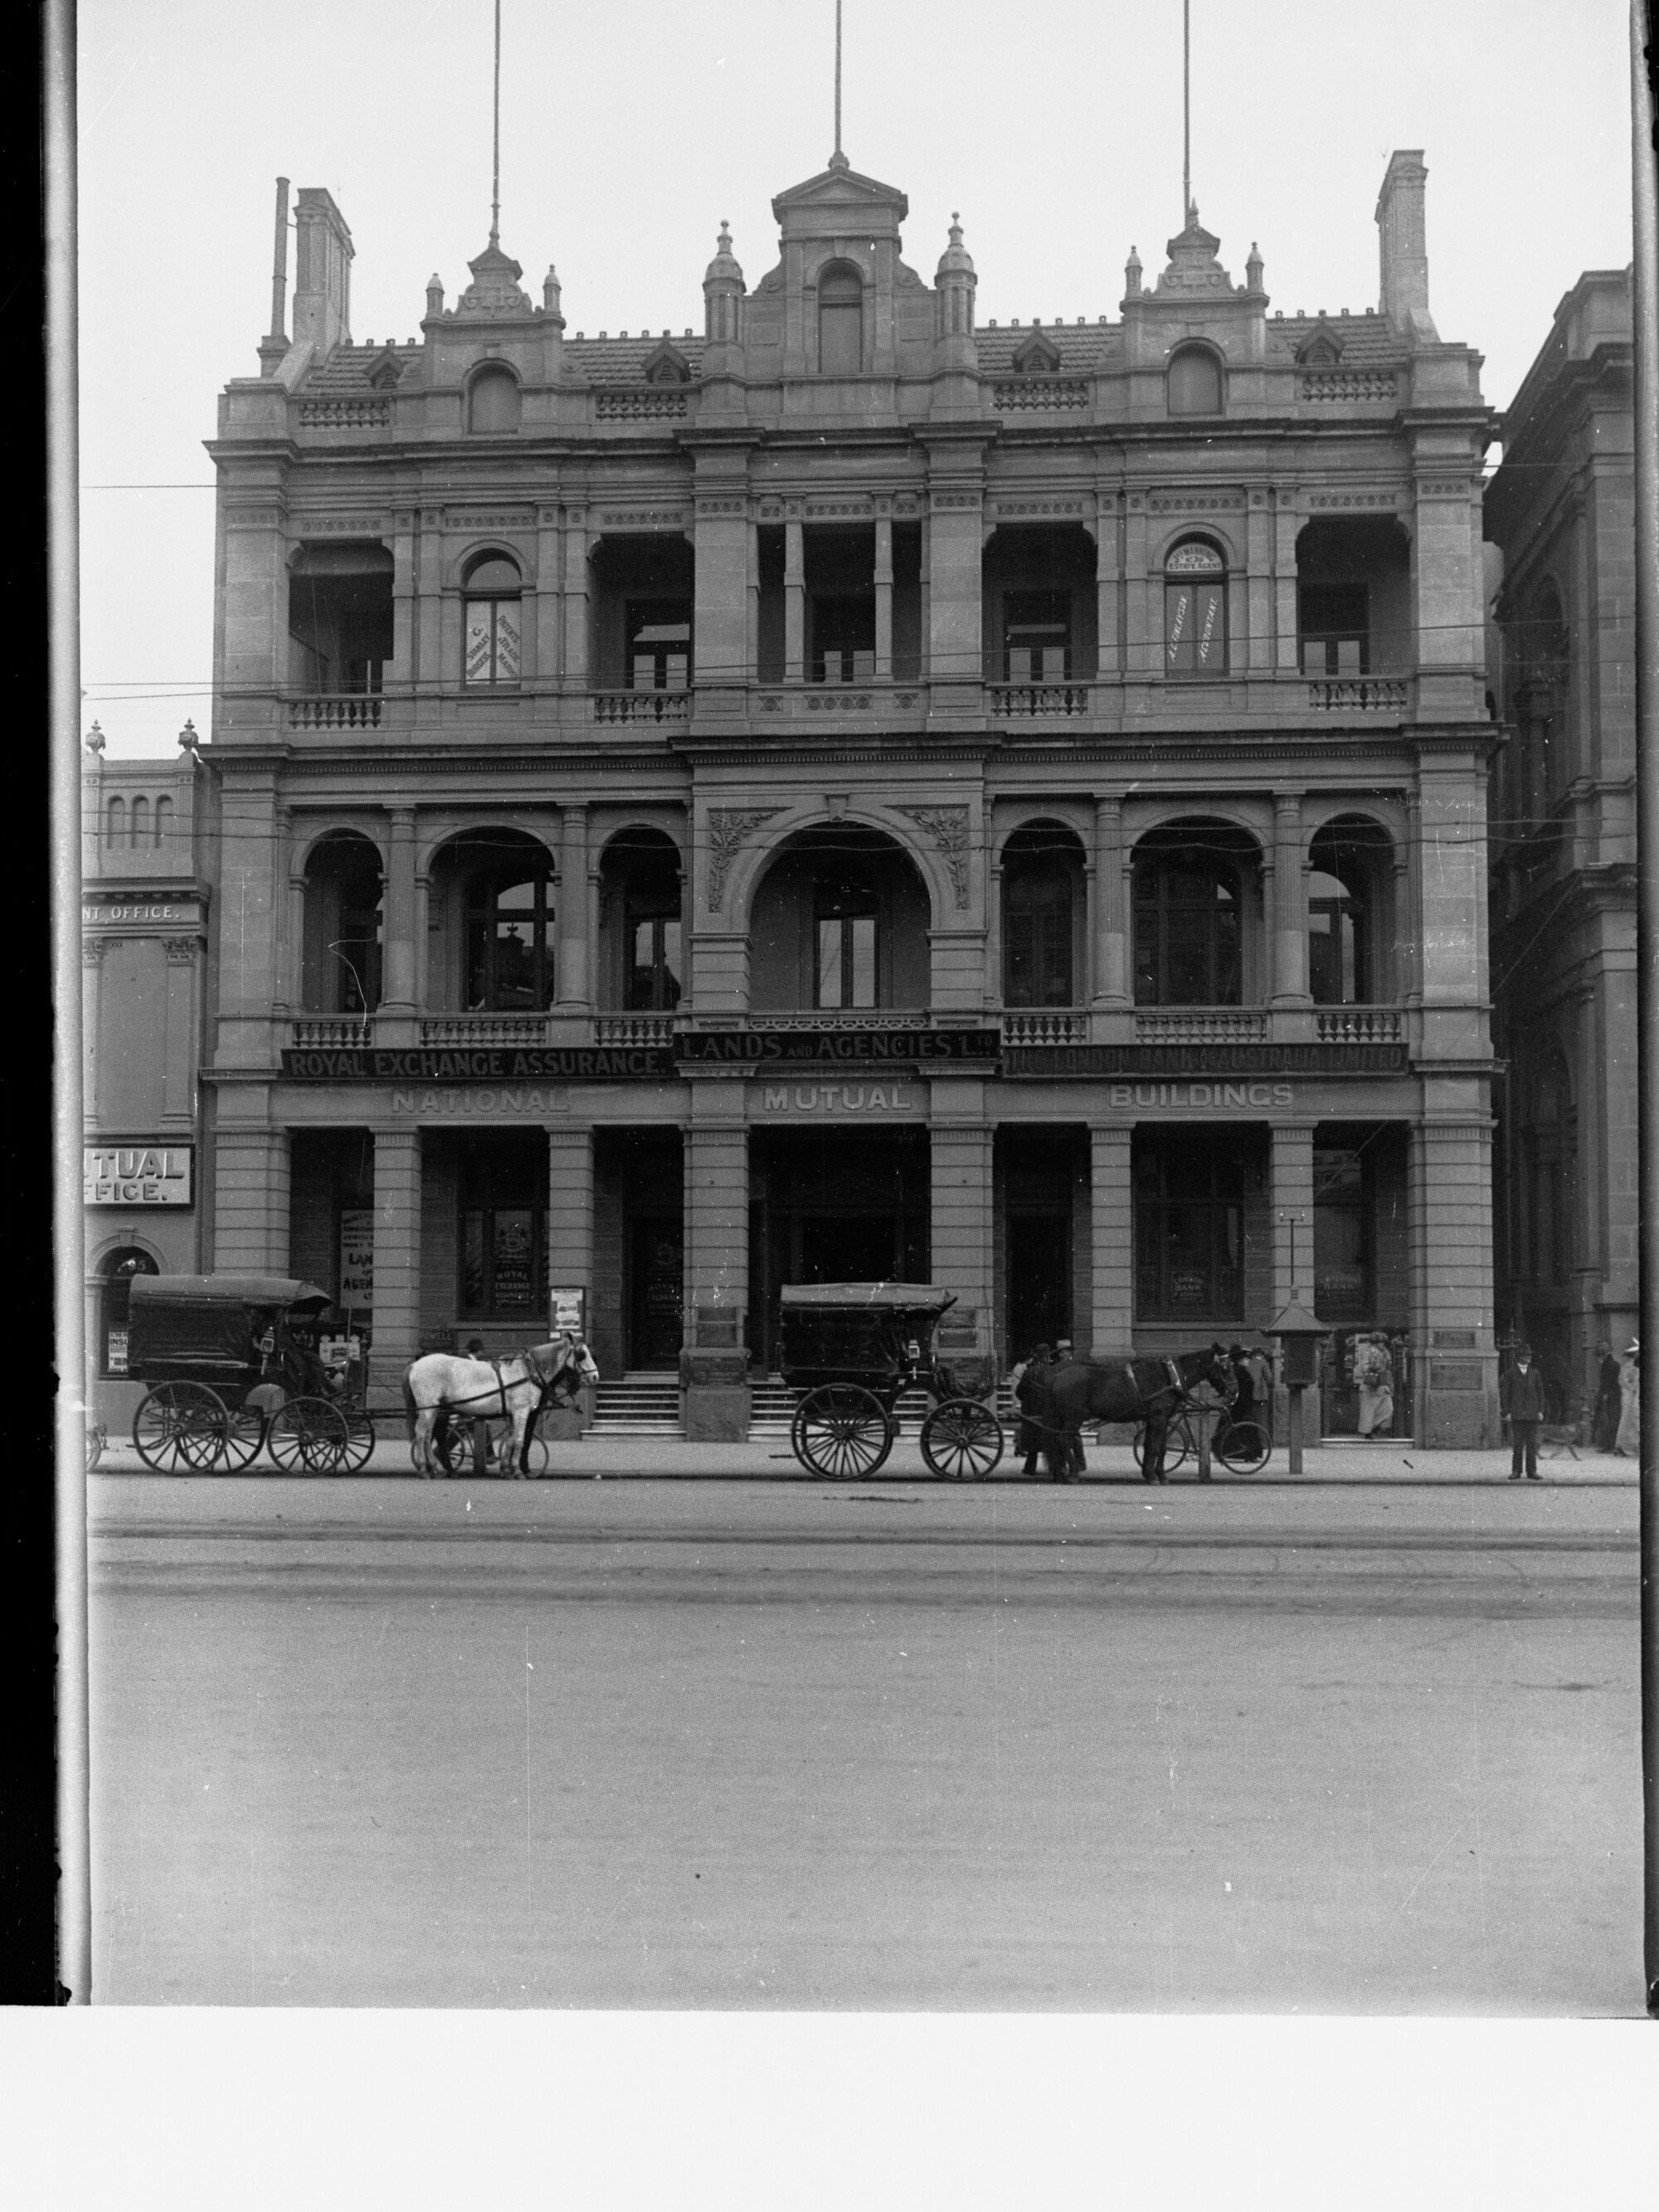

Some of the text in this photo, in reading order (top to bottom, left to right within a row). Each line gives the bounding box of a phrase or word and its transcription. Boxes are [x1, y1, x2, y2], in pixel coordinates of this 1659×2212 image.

[498, 615, 520, 644] PATENTS
[467, 632, 491, 660] STANLEY
[110, 906, 180, 919] OFFICE.
[683, 1035, 782, 1059] LANDS
[786, 1045, 812, 1057] AND
[819, 1034, 952, 1059] AGENCIES
[1140, 1047, 1193, 1069] BANK
[1218, 1046, 1321, 1069] AUSTRALIA
[1329, 1046, 1402, 1069] LIMITED
[290, 1052, 366, 1076] ROYAL
[373, 1051, 503, 1076] EXCHANGE
[392, 1089, 570, 1112] NATIONAL
[764, 1086, 912, 1111] MUTUAL
[1109, 1083, 1294, 1108] BUILDINGS
[84, 1151, 185, 1179] TUAL
[496, 1270, 528, 1281] ROYAL
